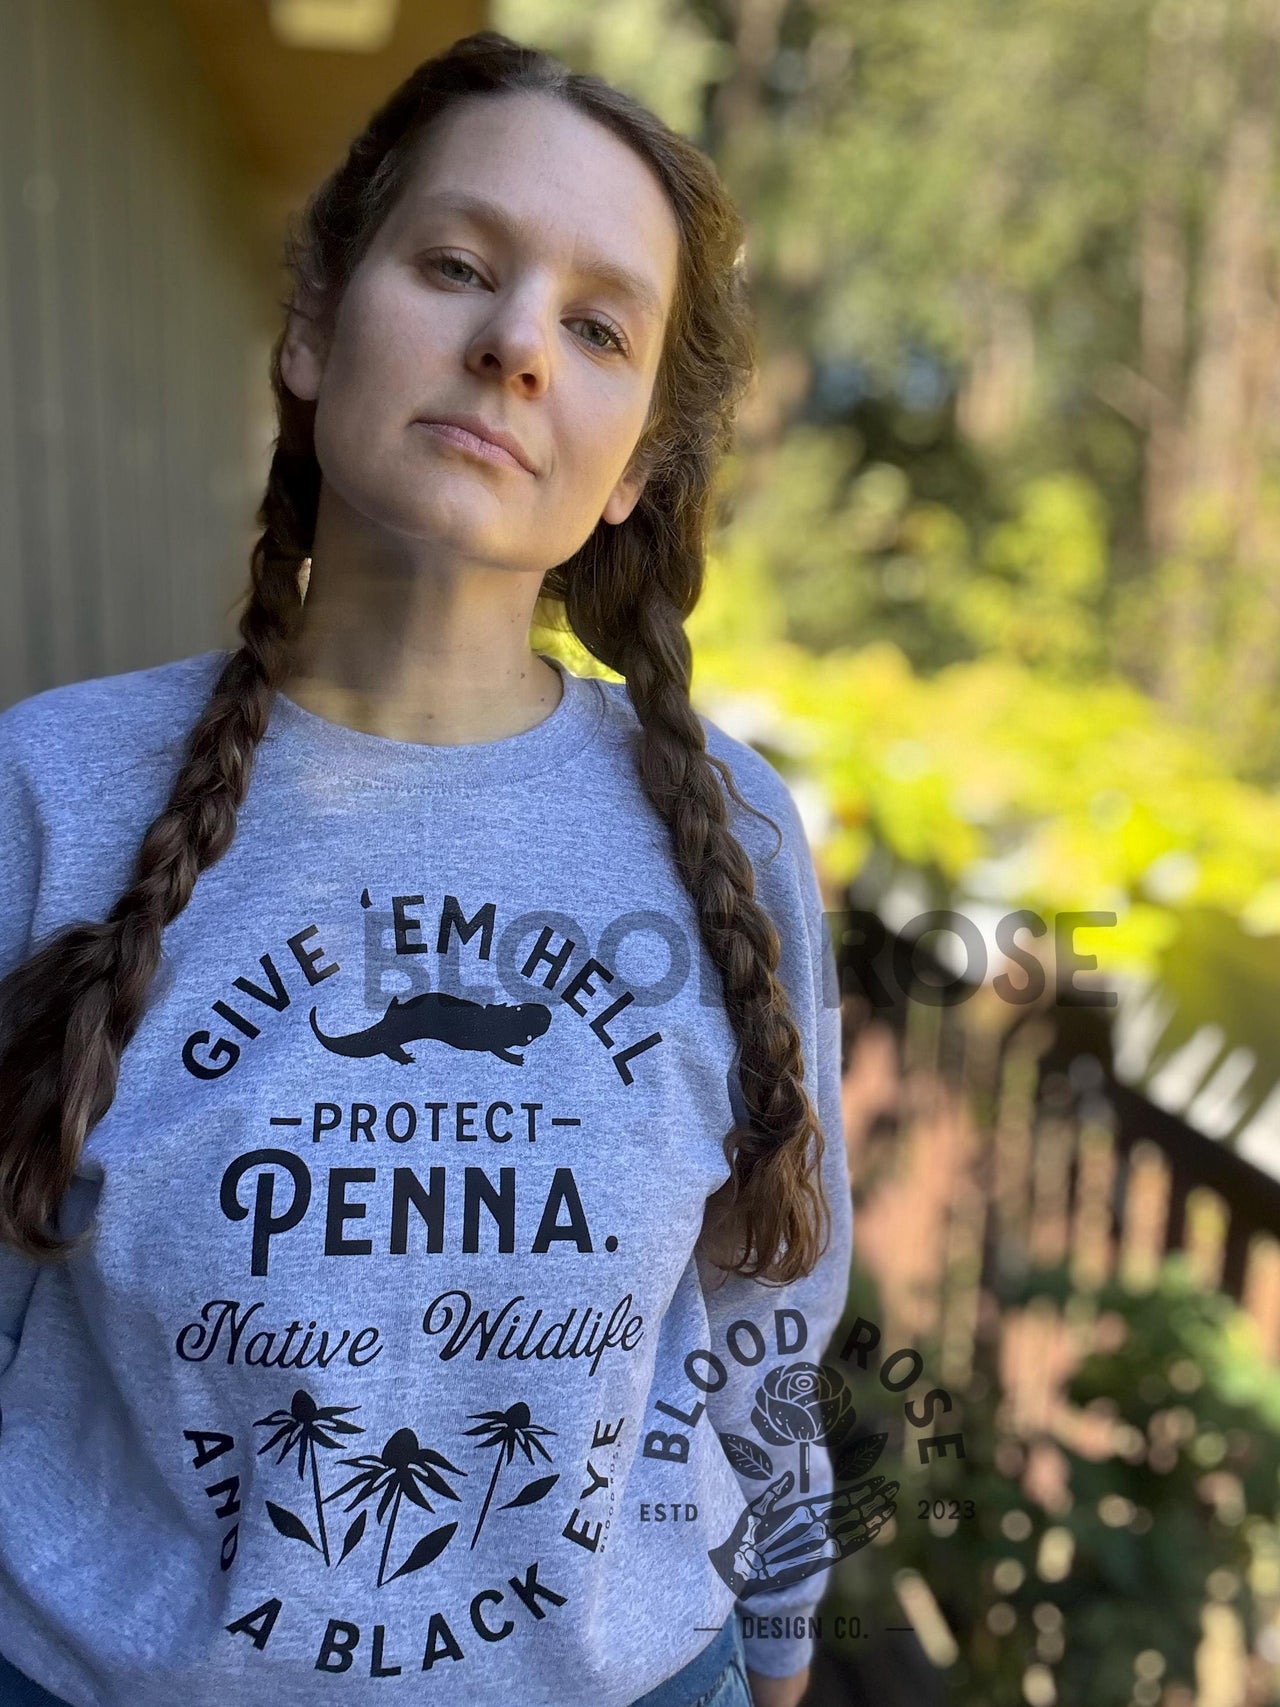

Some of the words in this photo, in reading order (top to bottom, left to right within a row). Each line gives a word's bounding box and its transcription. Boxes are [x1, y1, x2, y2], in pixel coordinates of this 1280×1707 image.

[182, 925, 340, 1080] GIVE
[521, 926, 664, 1086] HELL
[219, 1148, 620, 1277] PENNA.
[176, 1299, 384, 1368] Native
[423, 1290, 644, 1377] Wildlife
[182, 1429, 242, 1572] AND
[225, 1597, 283, 1651] A
[315, 1562, 568, 1678] BLACK
[562, 1417, 624, 1553] EYE
